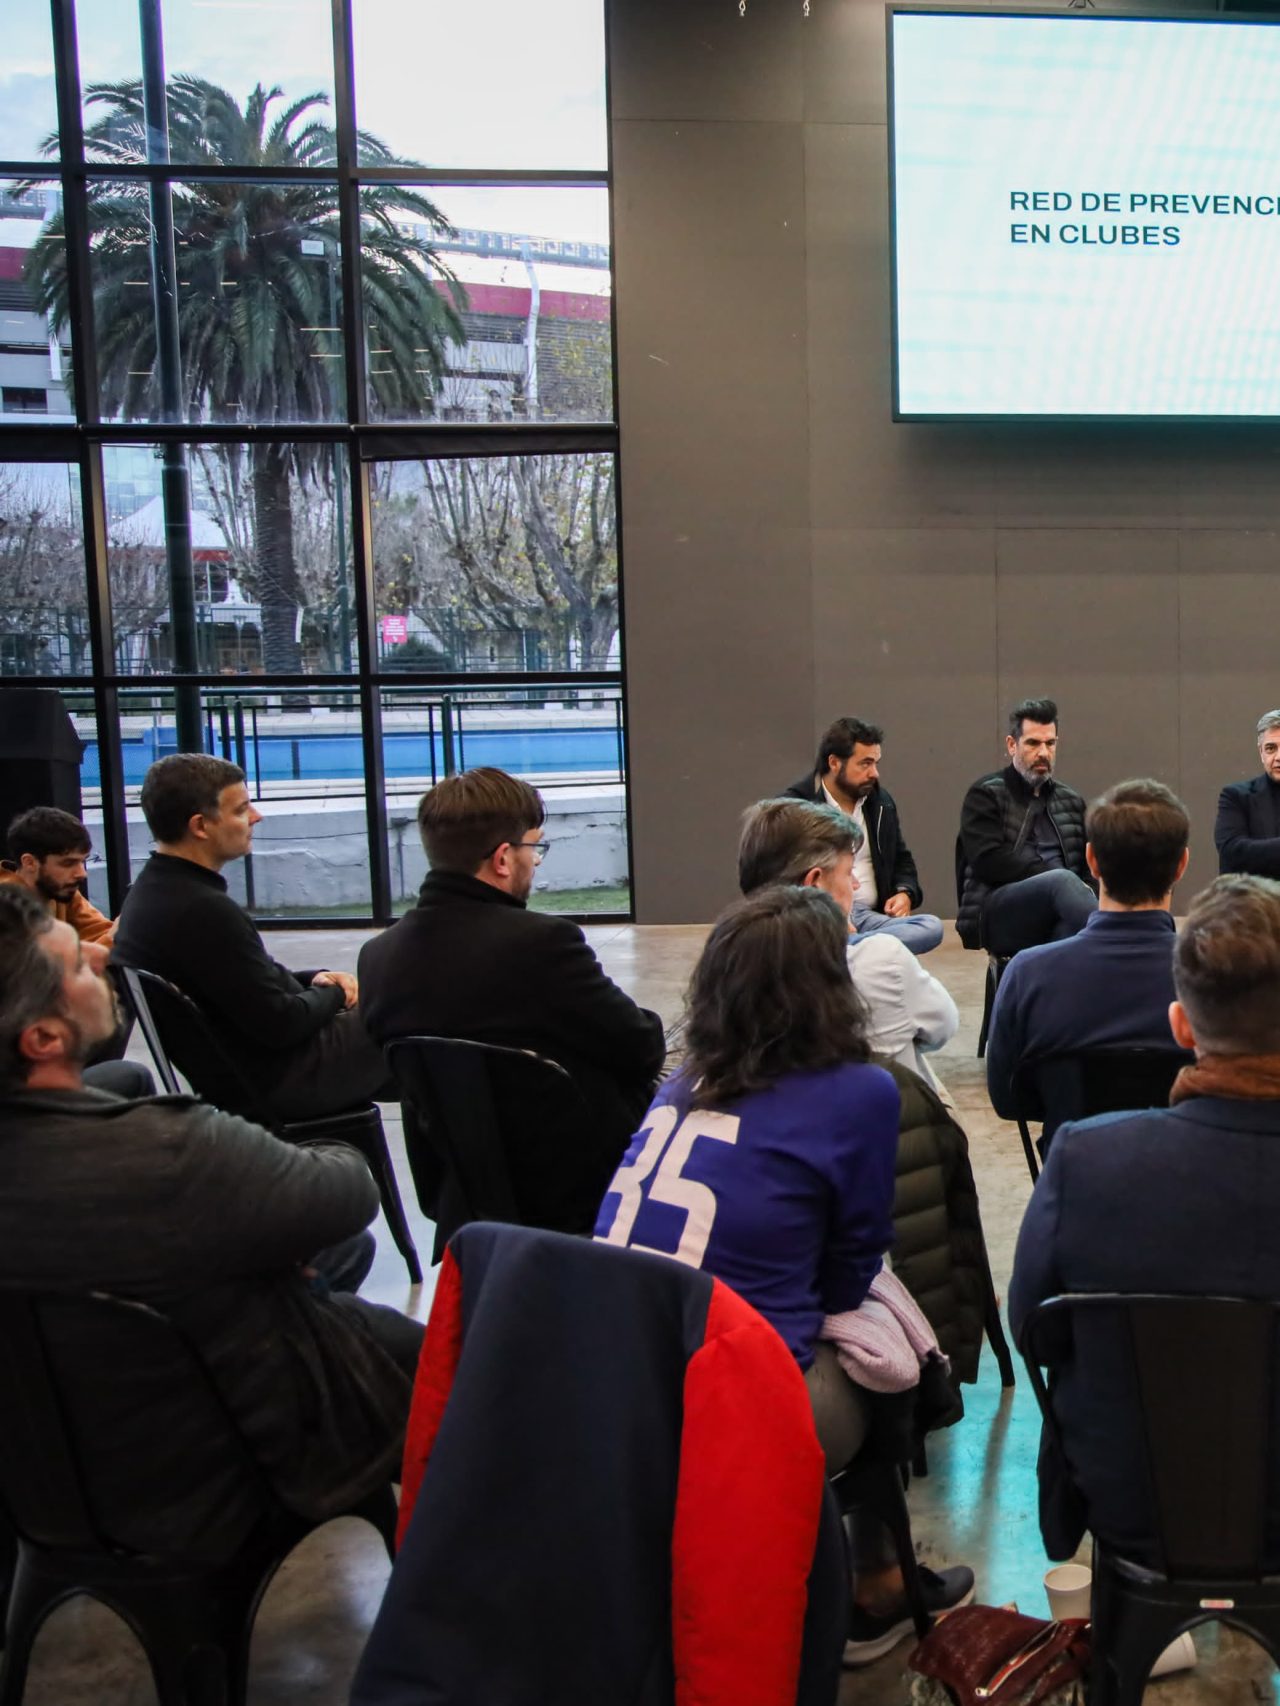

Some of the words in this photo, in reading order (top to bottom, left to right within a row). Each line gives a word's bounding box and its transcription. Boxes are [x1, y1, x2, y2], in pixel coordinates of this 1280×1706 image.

[1010, 191, 1073, 211] RED
[1081, 193, 1121, 212] DE
[1010, 224, 1051, 243] EN
[1059, 224, 1181, 246] CLUBES
